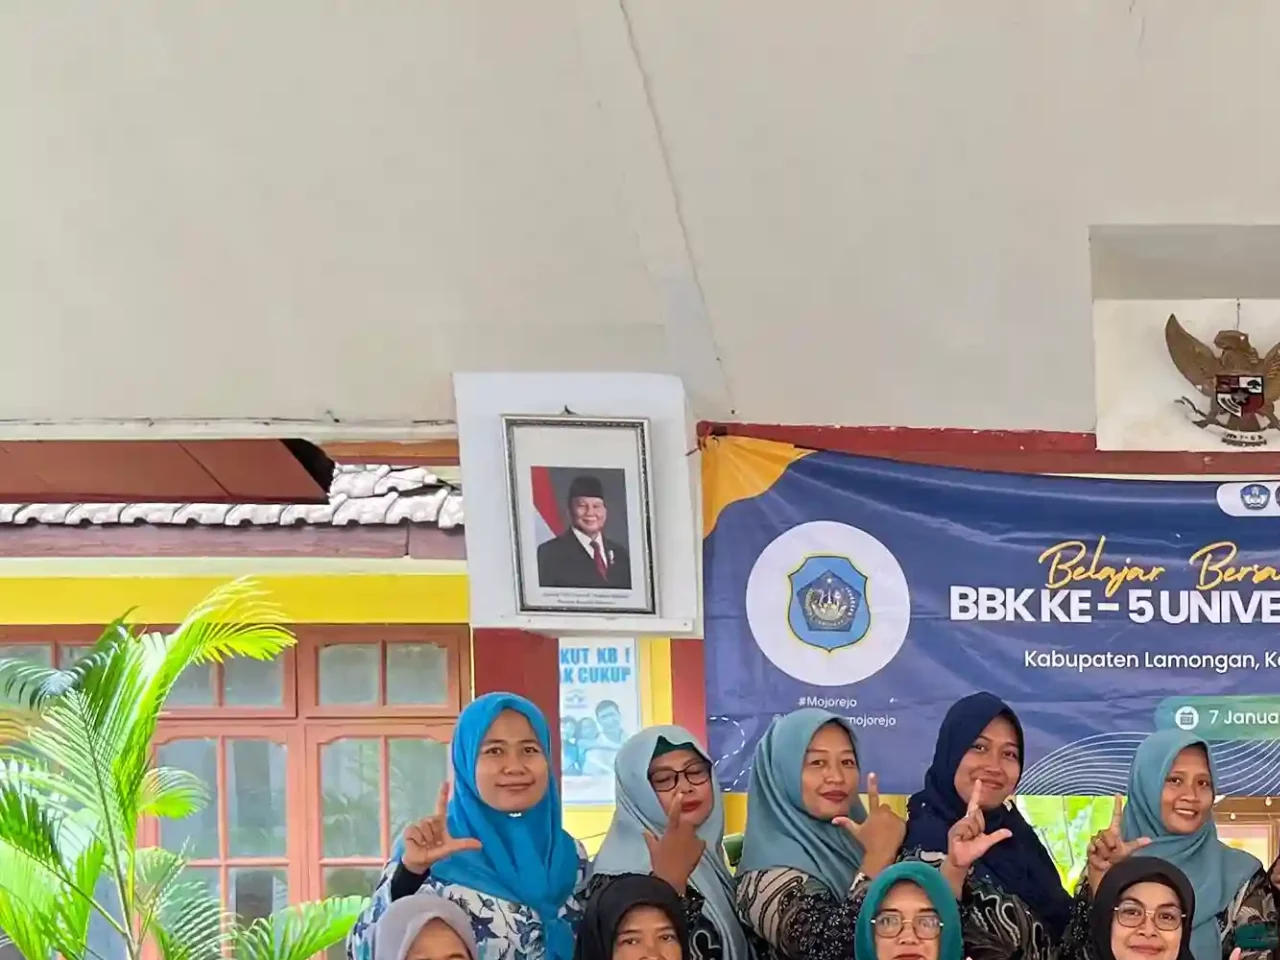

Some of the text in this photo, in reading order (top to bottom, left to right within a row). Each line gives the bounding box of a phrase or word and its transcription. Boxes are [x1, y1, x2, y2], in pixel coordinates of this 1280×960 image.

[1038, 535, 1166, 598] Belajar
[949, 586, 1036, 622] BBK
[1041, 588, 1092, 623] KE
[1128, 588, 1155, 624] 5
[1024, 650, 1140, 673] Kabupaten
[1144, 651, 1260, 674] Lamongan,
[578, 667, 631, 683] CUKUP
[797, 696, 858, 709] #Mojorejo
[1208, 709, 1220, 725] 7
